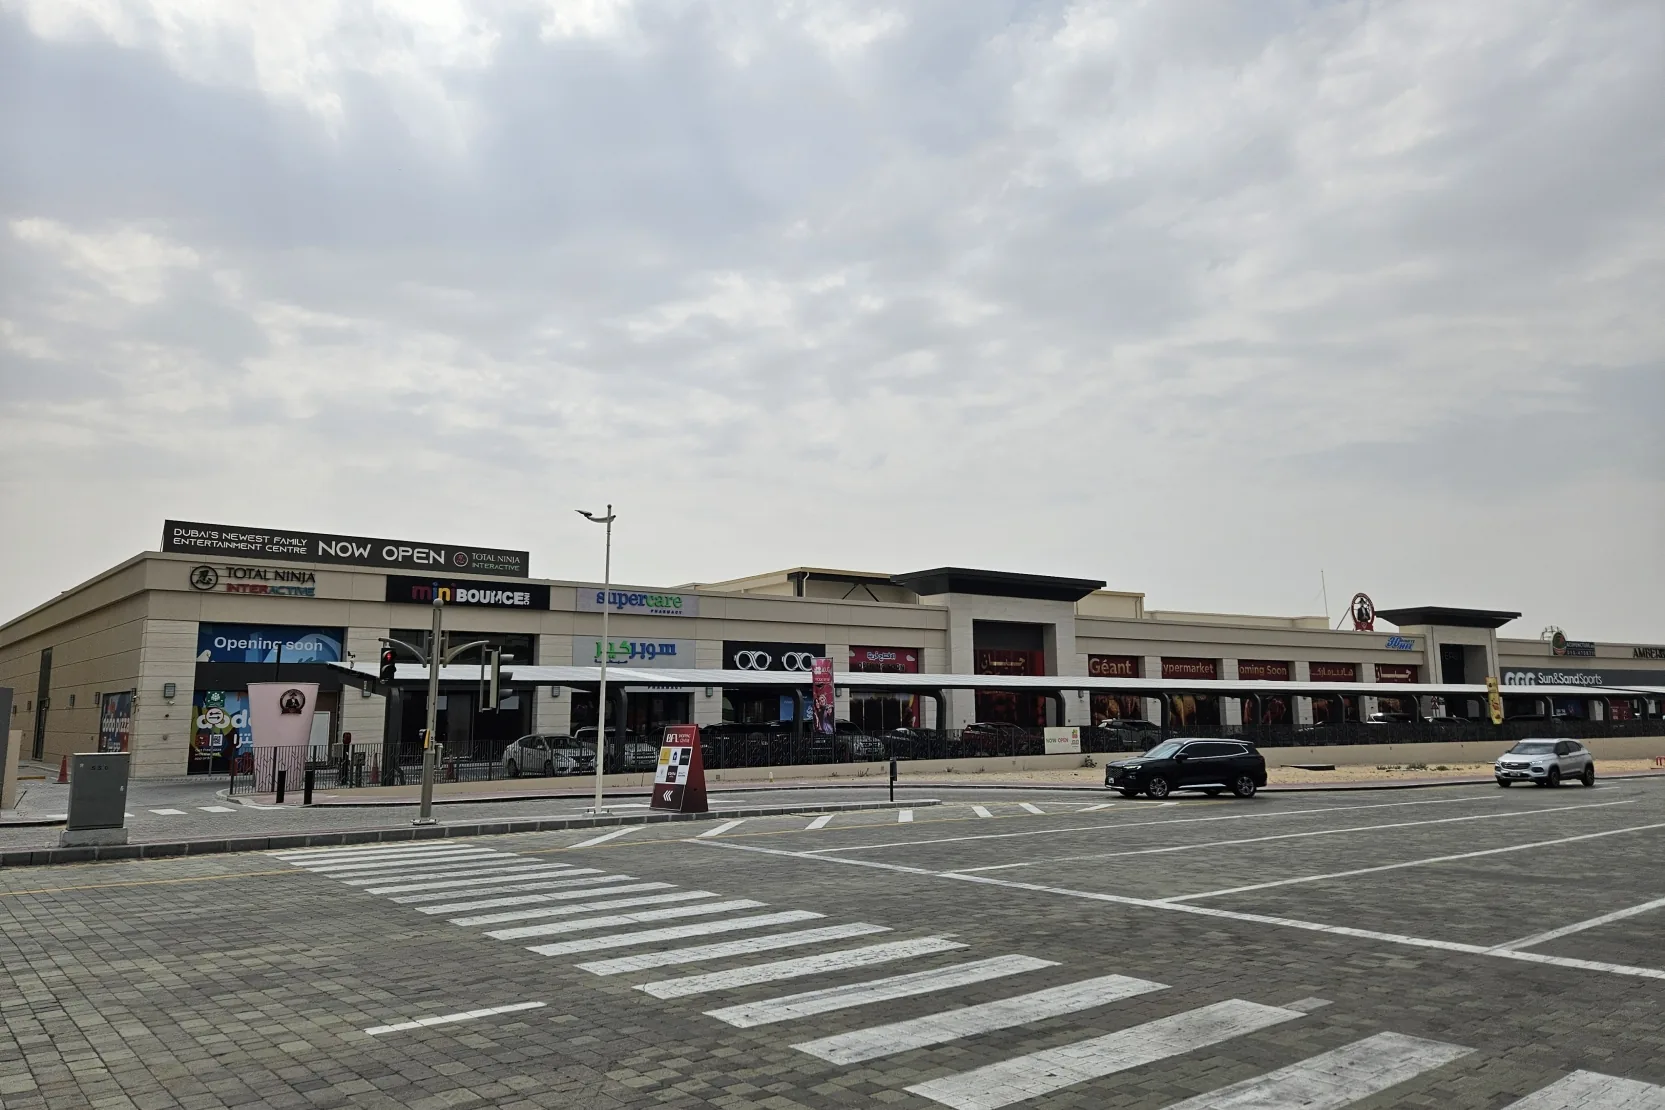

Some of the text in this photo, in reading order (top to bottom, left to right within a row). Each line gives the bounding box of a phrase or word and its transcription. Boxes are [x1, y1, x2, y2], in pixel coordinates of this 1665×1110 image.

[173, 528, 308, 546] DUBAI'S NEWEST FAMILY
[173, 537, 308, 555] ENTERTAINMENT CENTRE
[318, 540, 372, 559] NOW
[382, 545, 445, 565] OPEN
[471, 552, 496, 562] TOTAL
[497, 555, 521, 565] NINJA
[471, 562, 521, 572] INTERACTIVE
[226, 567, 316, 585] TOTAL NINJA
[226, 583, 316, 597] INTERACTIVE
[596, 591, 682, 610] supercare
[214, 636, 323, 652] Opening soon
[1089, 658, 1132, 675] Géant
[1266, 665, 1287, 676] Soon
